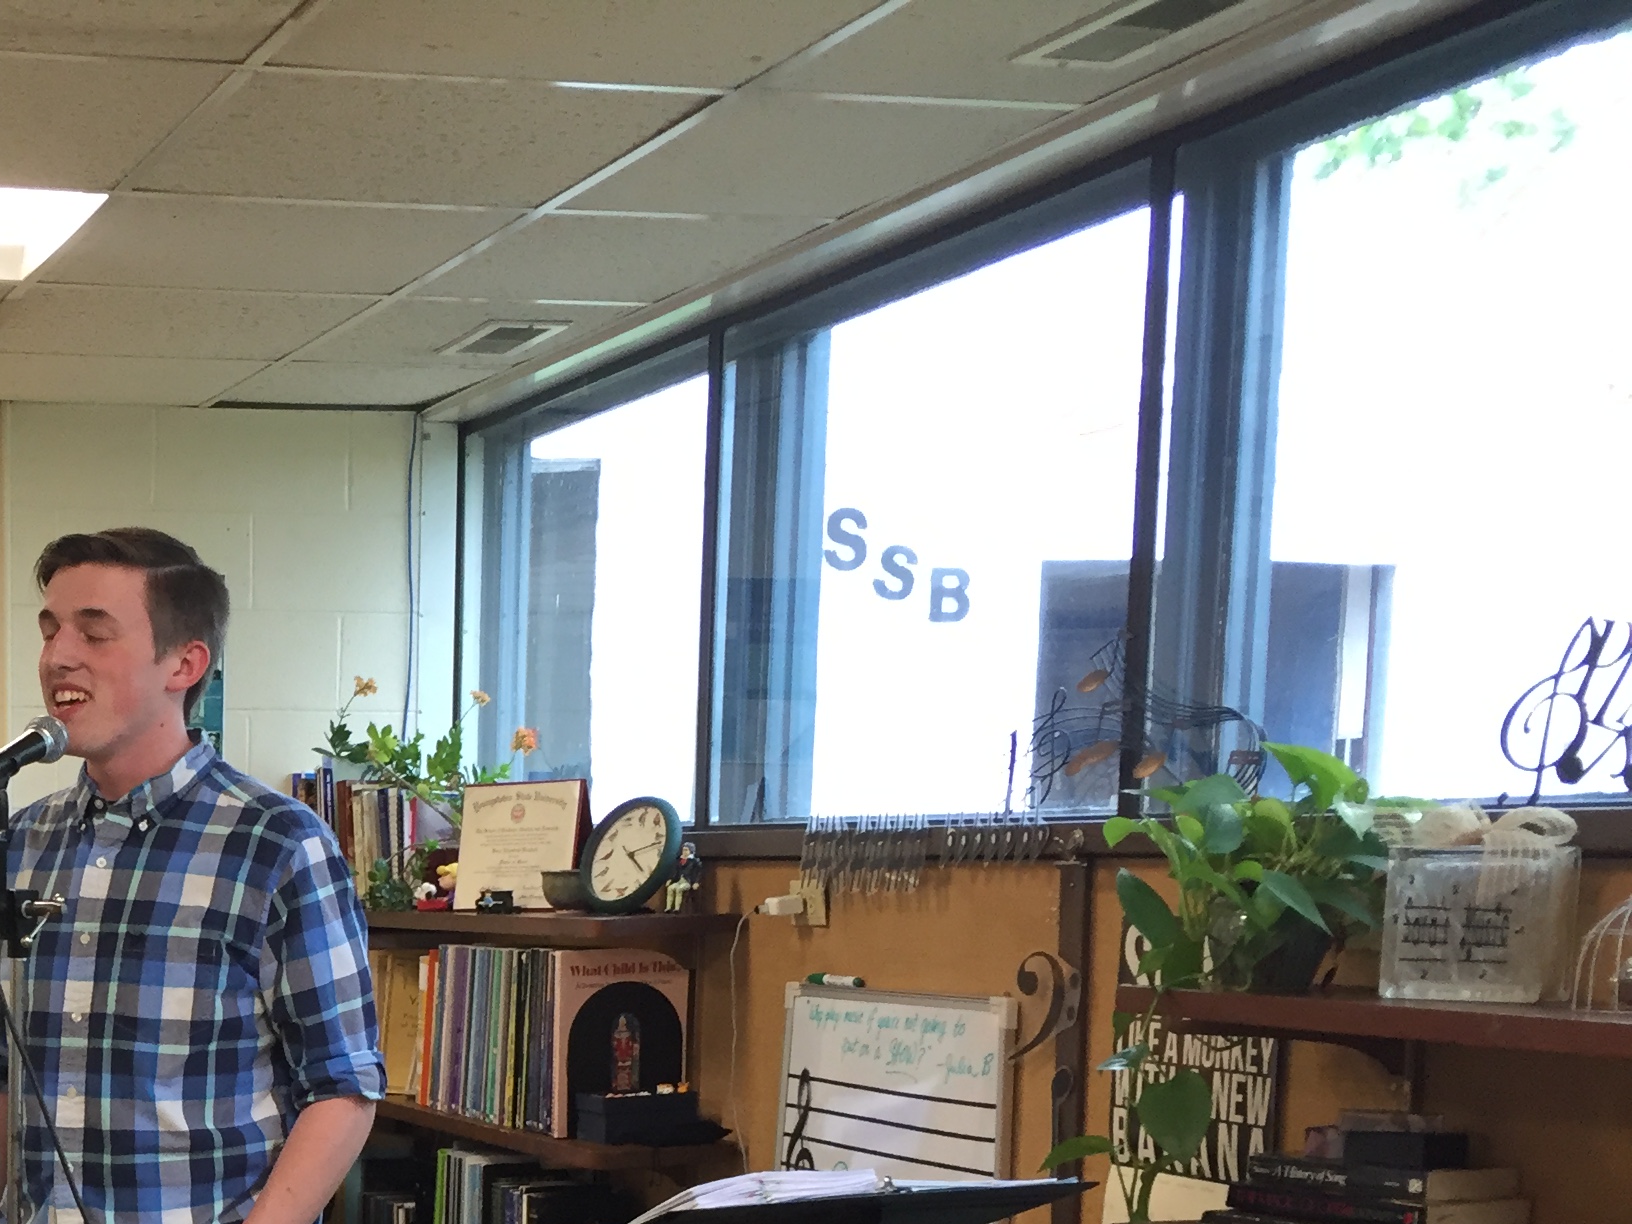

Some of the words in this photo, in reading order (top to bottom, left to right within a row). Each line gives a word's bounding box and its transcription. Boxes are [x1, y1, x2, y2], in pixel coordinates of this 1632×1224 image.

[570, 964, 602, 977] What
[603, 962, 636, 976] Child
[953, 1013, 966, 1038] to
[1163, 1030, 1179, 1065] A
[1182, 1033, 1275, 1075] MONKEY
[1211, 1070, 1273, 1127] NEW
[1283, 1164, 1315, 1183] History
